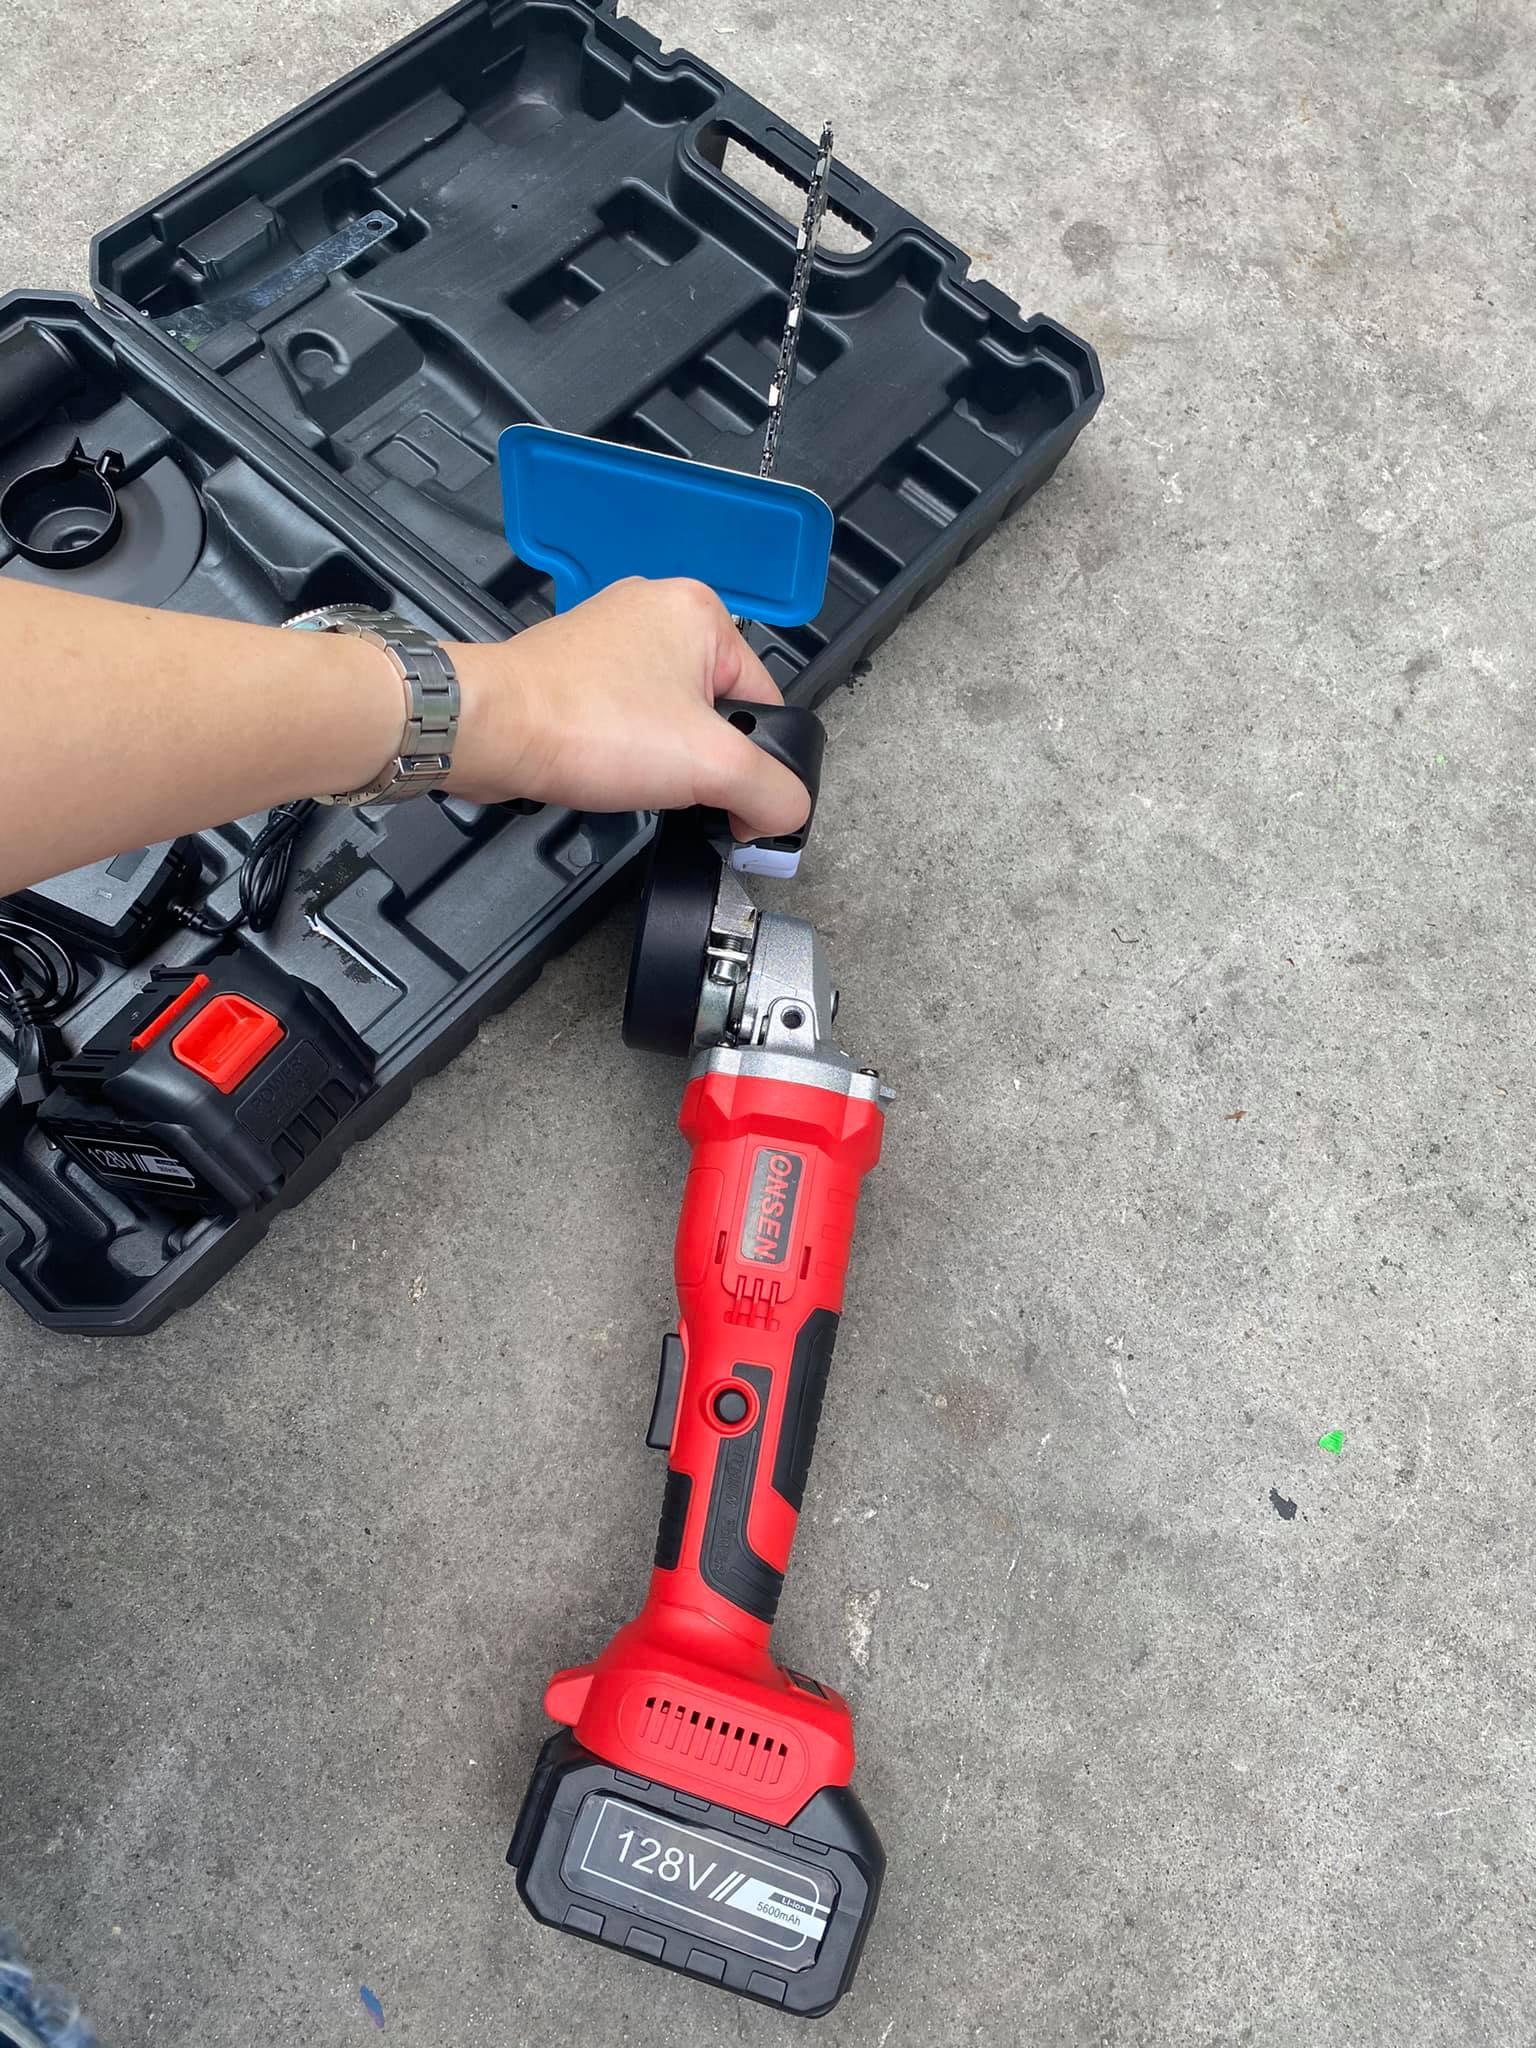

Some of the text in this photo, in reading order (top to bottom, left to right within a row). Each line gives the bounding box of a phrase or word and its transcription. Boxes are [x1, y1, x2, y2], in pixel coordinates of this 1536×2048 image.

[88, 1148, 137, 1171] 128V
[753, 1154, 793, 1261] ONSEN
[617, 1830, 717, 1892] 128V
[756, 1901, 801, 1926] 5600mAh
